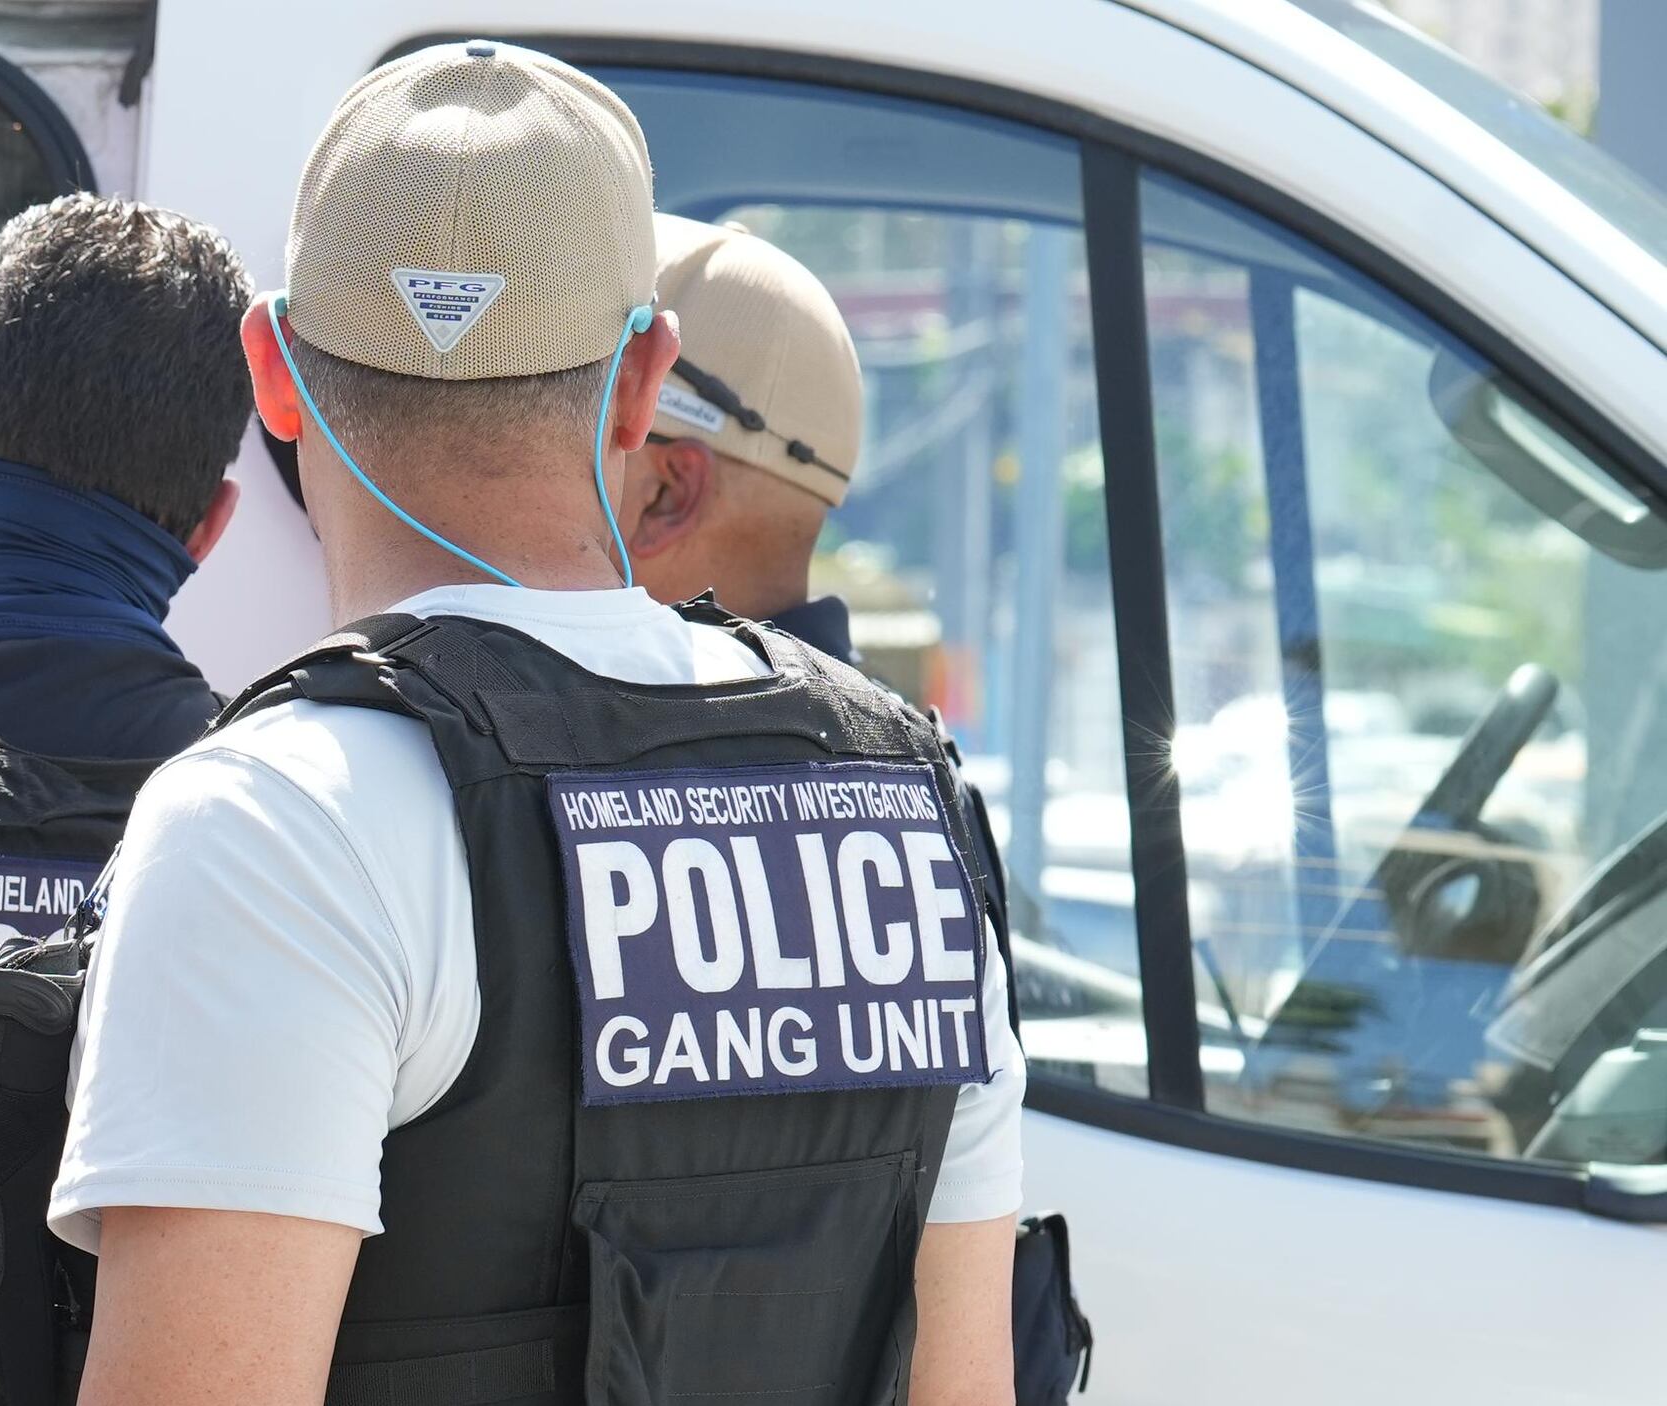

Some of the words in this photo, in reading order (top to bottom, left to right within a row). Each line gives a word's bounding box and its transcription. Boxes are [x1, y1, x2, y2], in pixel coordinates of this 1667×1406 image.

[408, 279, 486, 293] PFG
[415, 293, 477, 302] PERFORMANCE
[562, 789, 684, 831] HOMELAND
[689, 783, 789, 826] SECURITY
[791, 780, 939, 822] INVESTIGATIONS
[575, 831, 976, 1000] POLICE
[595, 1006, 819, 1087] GANG
[837, 996, 976, 1074] UNIT
